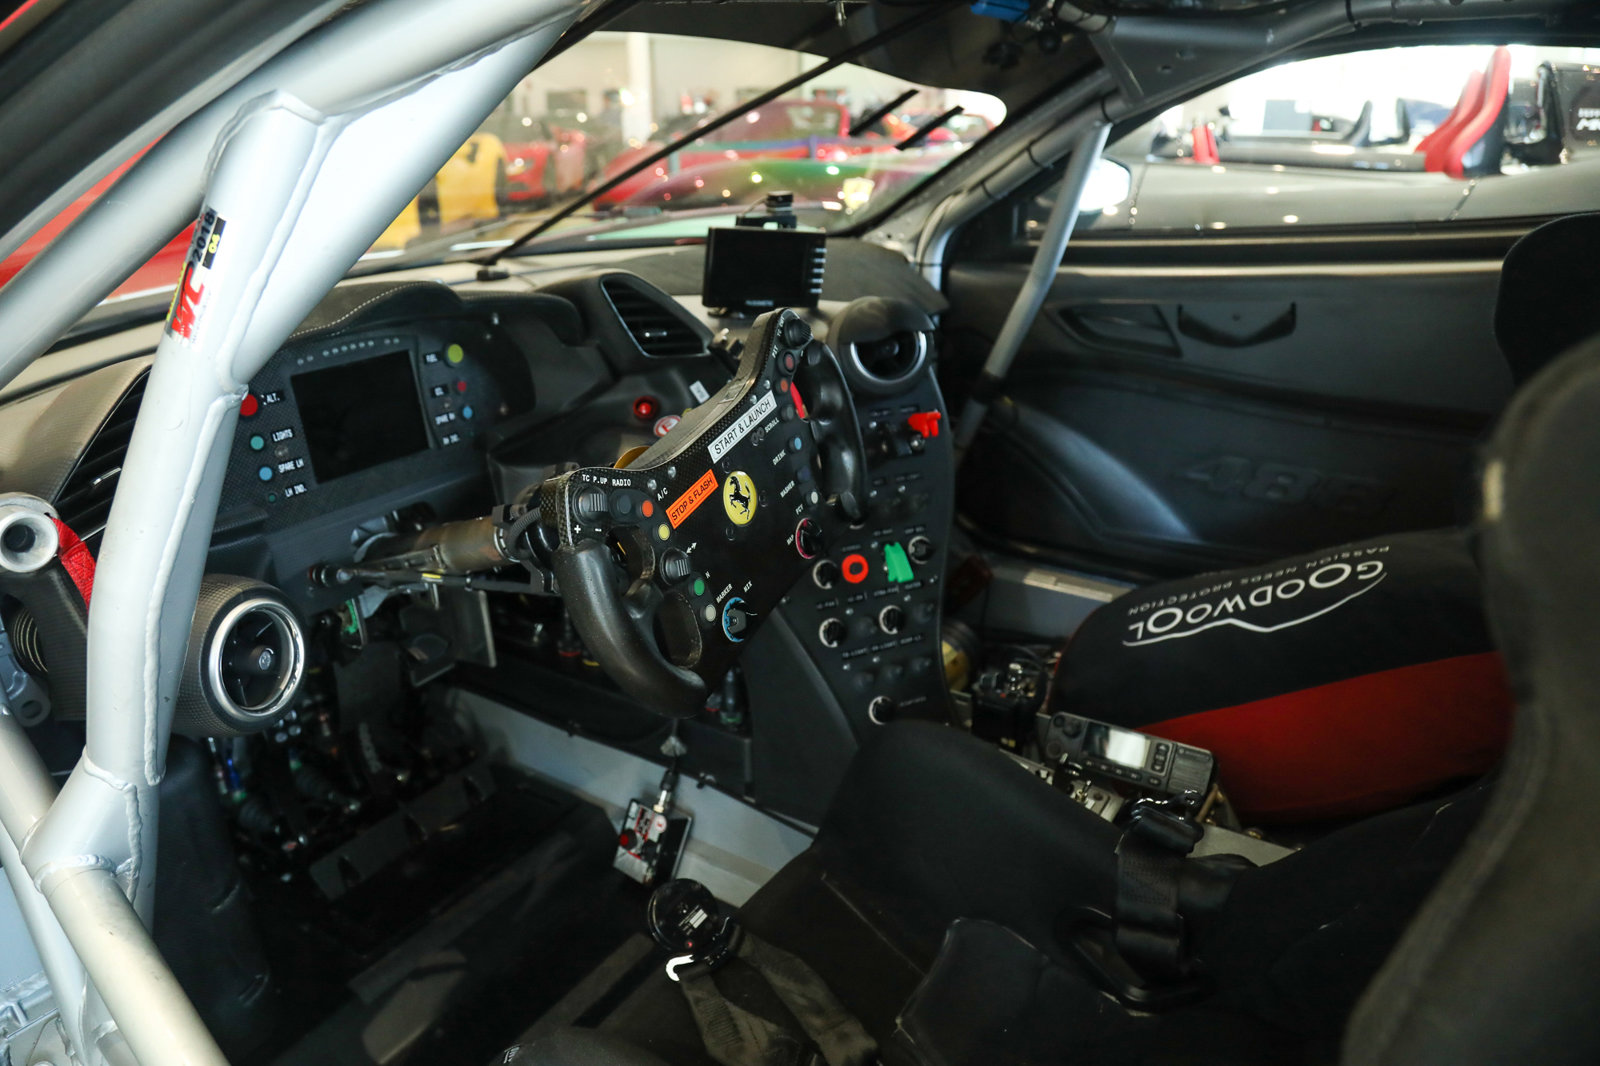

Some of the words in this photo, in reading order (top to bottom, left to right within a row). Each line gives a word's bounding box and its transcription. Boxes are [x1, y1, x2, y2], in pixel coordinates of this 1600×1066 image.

[191, 210, 216, 262] 2018
[771, 344, 780, 359] PIT
[713, 428, 738, 455] START
[738, 424, 746, 434] &
[745, 398, 772, 428] LAUNCH
[764, 417, 780, 433] SCROLL
[272, 428, 294, 442] LIGHTS
[772, 449, 788, 466] DRINK
[582, 474, 591, 483] TC
[611, 478, 632, 487] RADIO
[692, 477, 713, 500] FLASH
[780, 480, 796, 498] WASHER
[656, 487, 669, 501] A/C
[688, 495, 697, 505] &
[670, 501, 689, 521] STOP
[786, 533, 795, 546] MAP
[1305, 545, 1390, 569] PASSION
[1239, 565, 1298, 586] NEEDS
[715, 583, 733, 604] MARKER
[743, 580, 753, 593] MIX
[1127, 581, 1233, 616] PROTECTION
[1128, 560, 1385, 640] GOODWOOL
